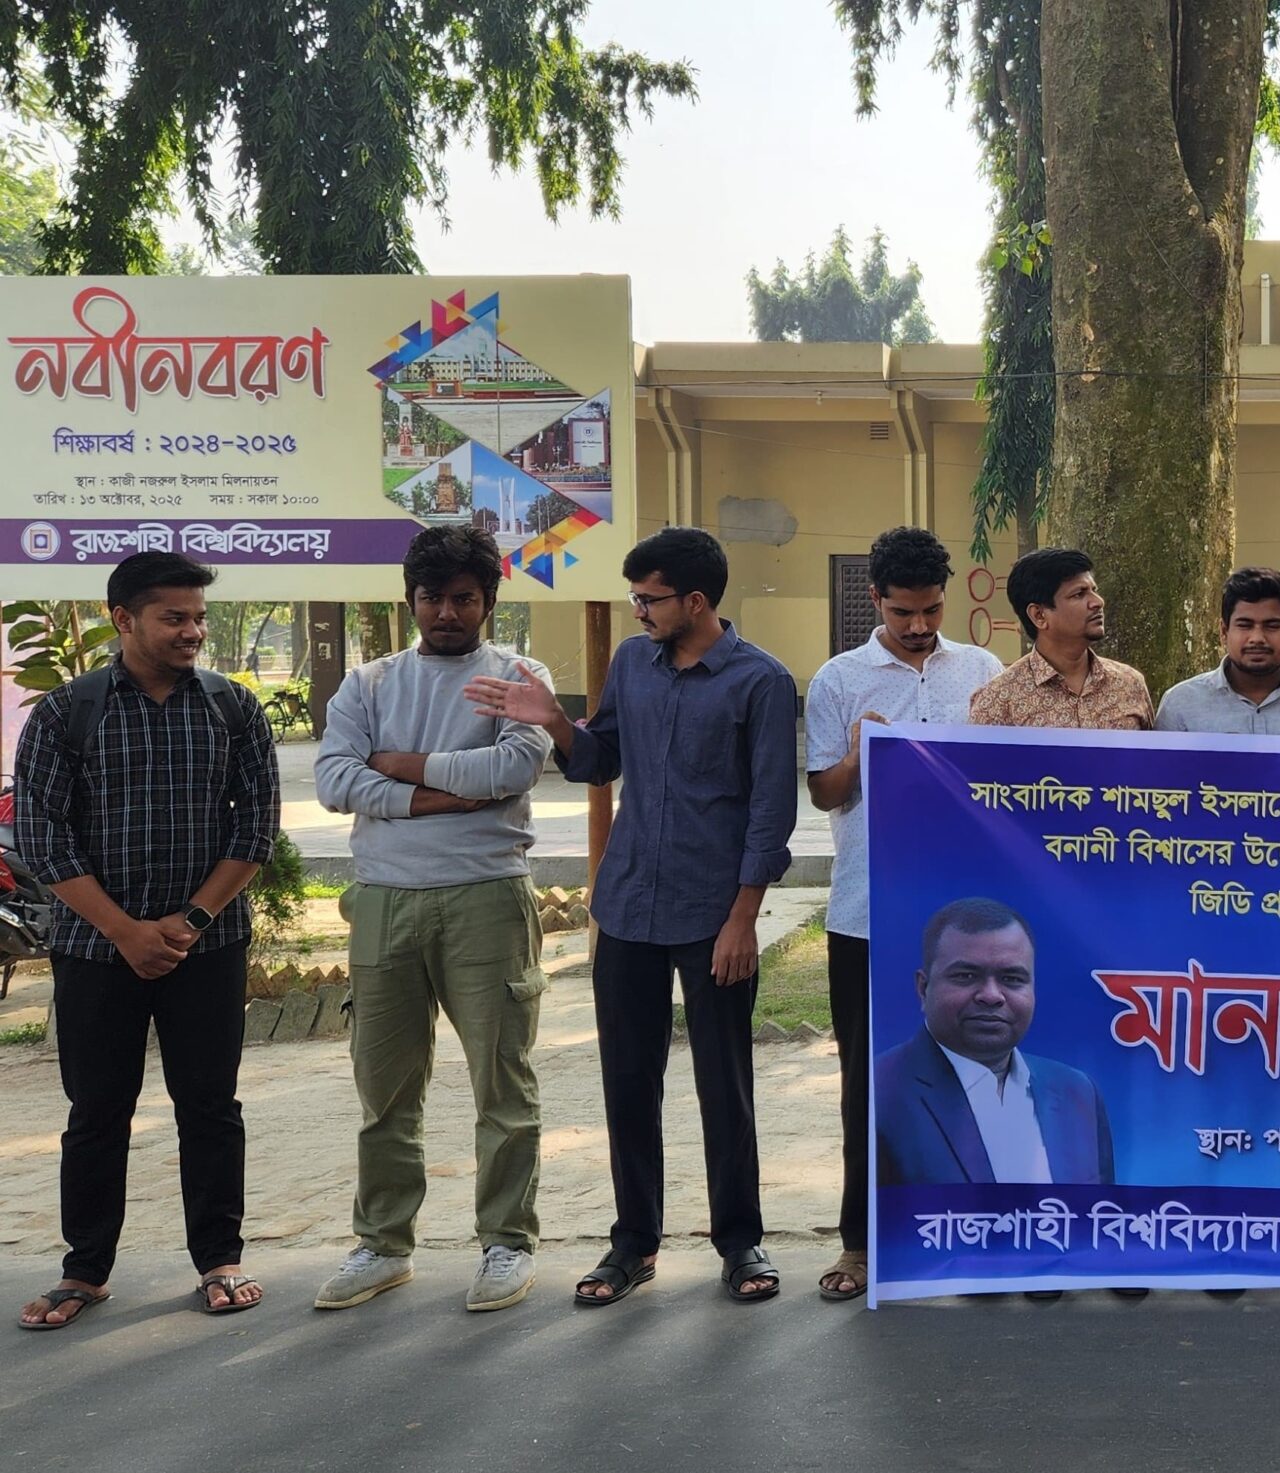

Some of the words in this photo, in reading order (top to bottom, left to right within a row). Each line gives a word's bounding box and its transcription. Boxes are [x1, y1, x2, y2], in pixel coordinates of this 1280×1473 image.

[7, 285, 331, 414] নবীনবরণ
[53, 427, 135, 453] শিক্ষাবর্ষ
[160, 435, 297, 455] ২০২৪-২০২৫
[74, 475, 95, 487] স্থান
[109, 474, 135, 487] কাজী
[139, 477, 176, 487] নজরুল
[181, 474, 218, 487] ইসলাম
[222, 474, 279, 487] মিলনায়তন
[80, 495, 95, 504] ১৩
[150, 495, 182, 506] ২০২৫
[210, 495, 234, 505] সময়
[248, 494, 278, 505] সকাল
[70, 523, 174, 561] রাজশাহী
[180, 523, 331, 559] বিশ্ববিদ্যালয়
[968, 776, 1093, 812] সাংবাদিক
[1100, 785, 1192, 821] শামছুল
[1043, 827, 1120, 863] বনানী
[1126, 829, 1234, 866] বিশ্বাসের
[1188, 880, 1254, 917] জিডি
[913, 1198, 1078, 1253] রাজশাহী
